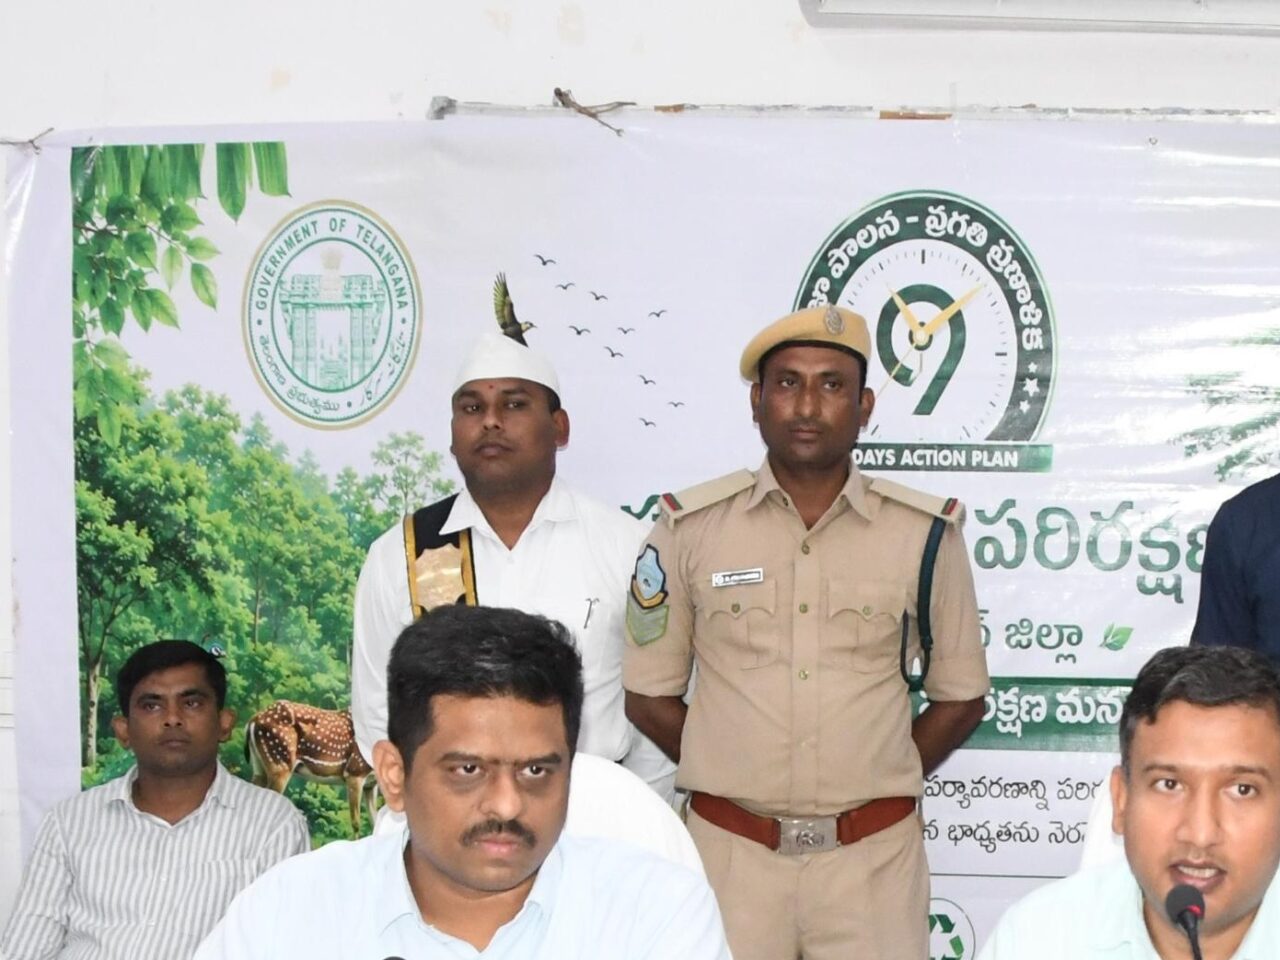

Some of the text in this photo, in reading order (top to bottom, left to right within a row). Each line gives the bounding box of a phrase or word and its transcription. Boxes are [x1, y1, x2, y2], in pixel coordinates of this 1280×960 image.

[255, 216, 409, 311] GOVERNMENT OF TELANGANA
[852, 448, 1018, 468] DAYS ACTION PLAN
[1004, 617, 1084, 664] జిల్లా
